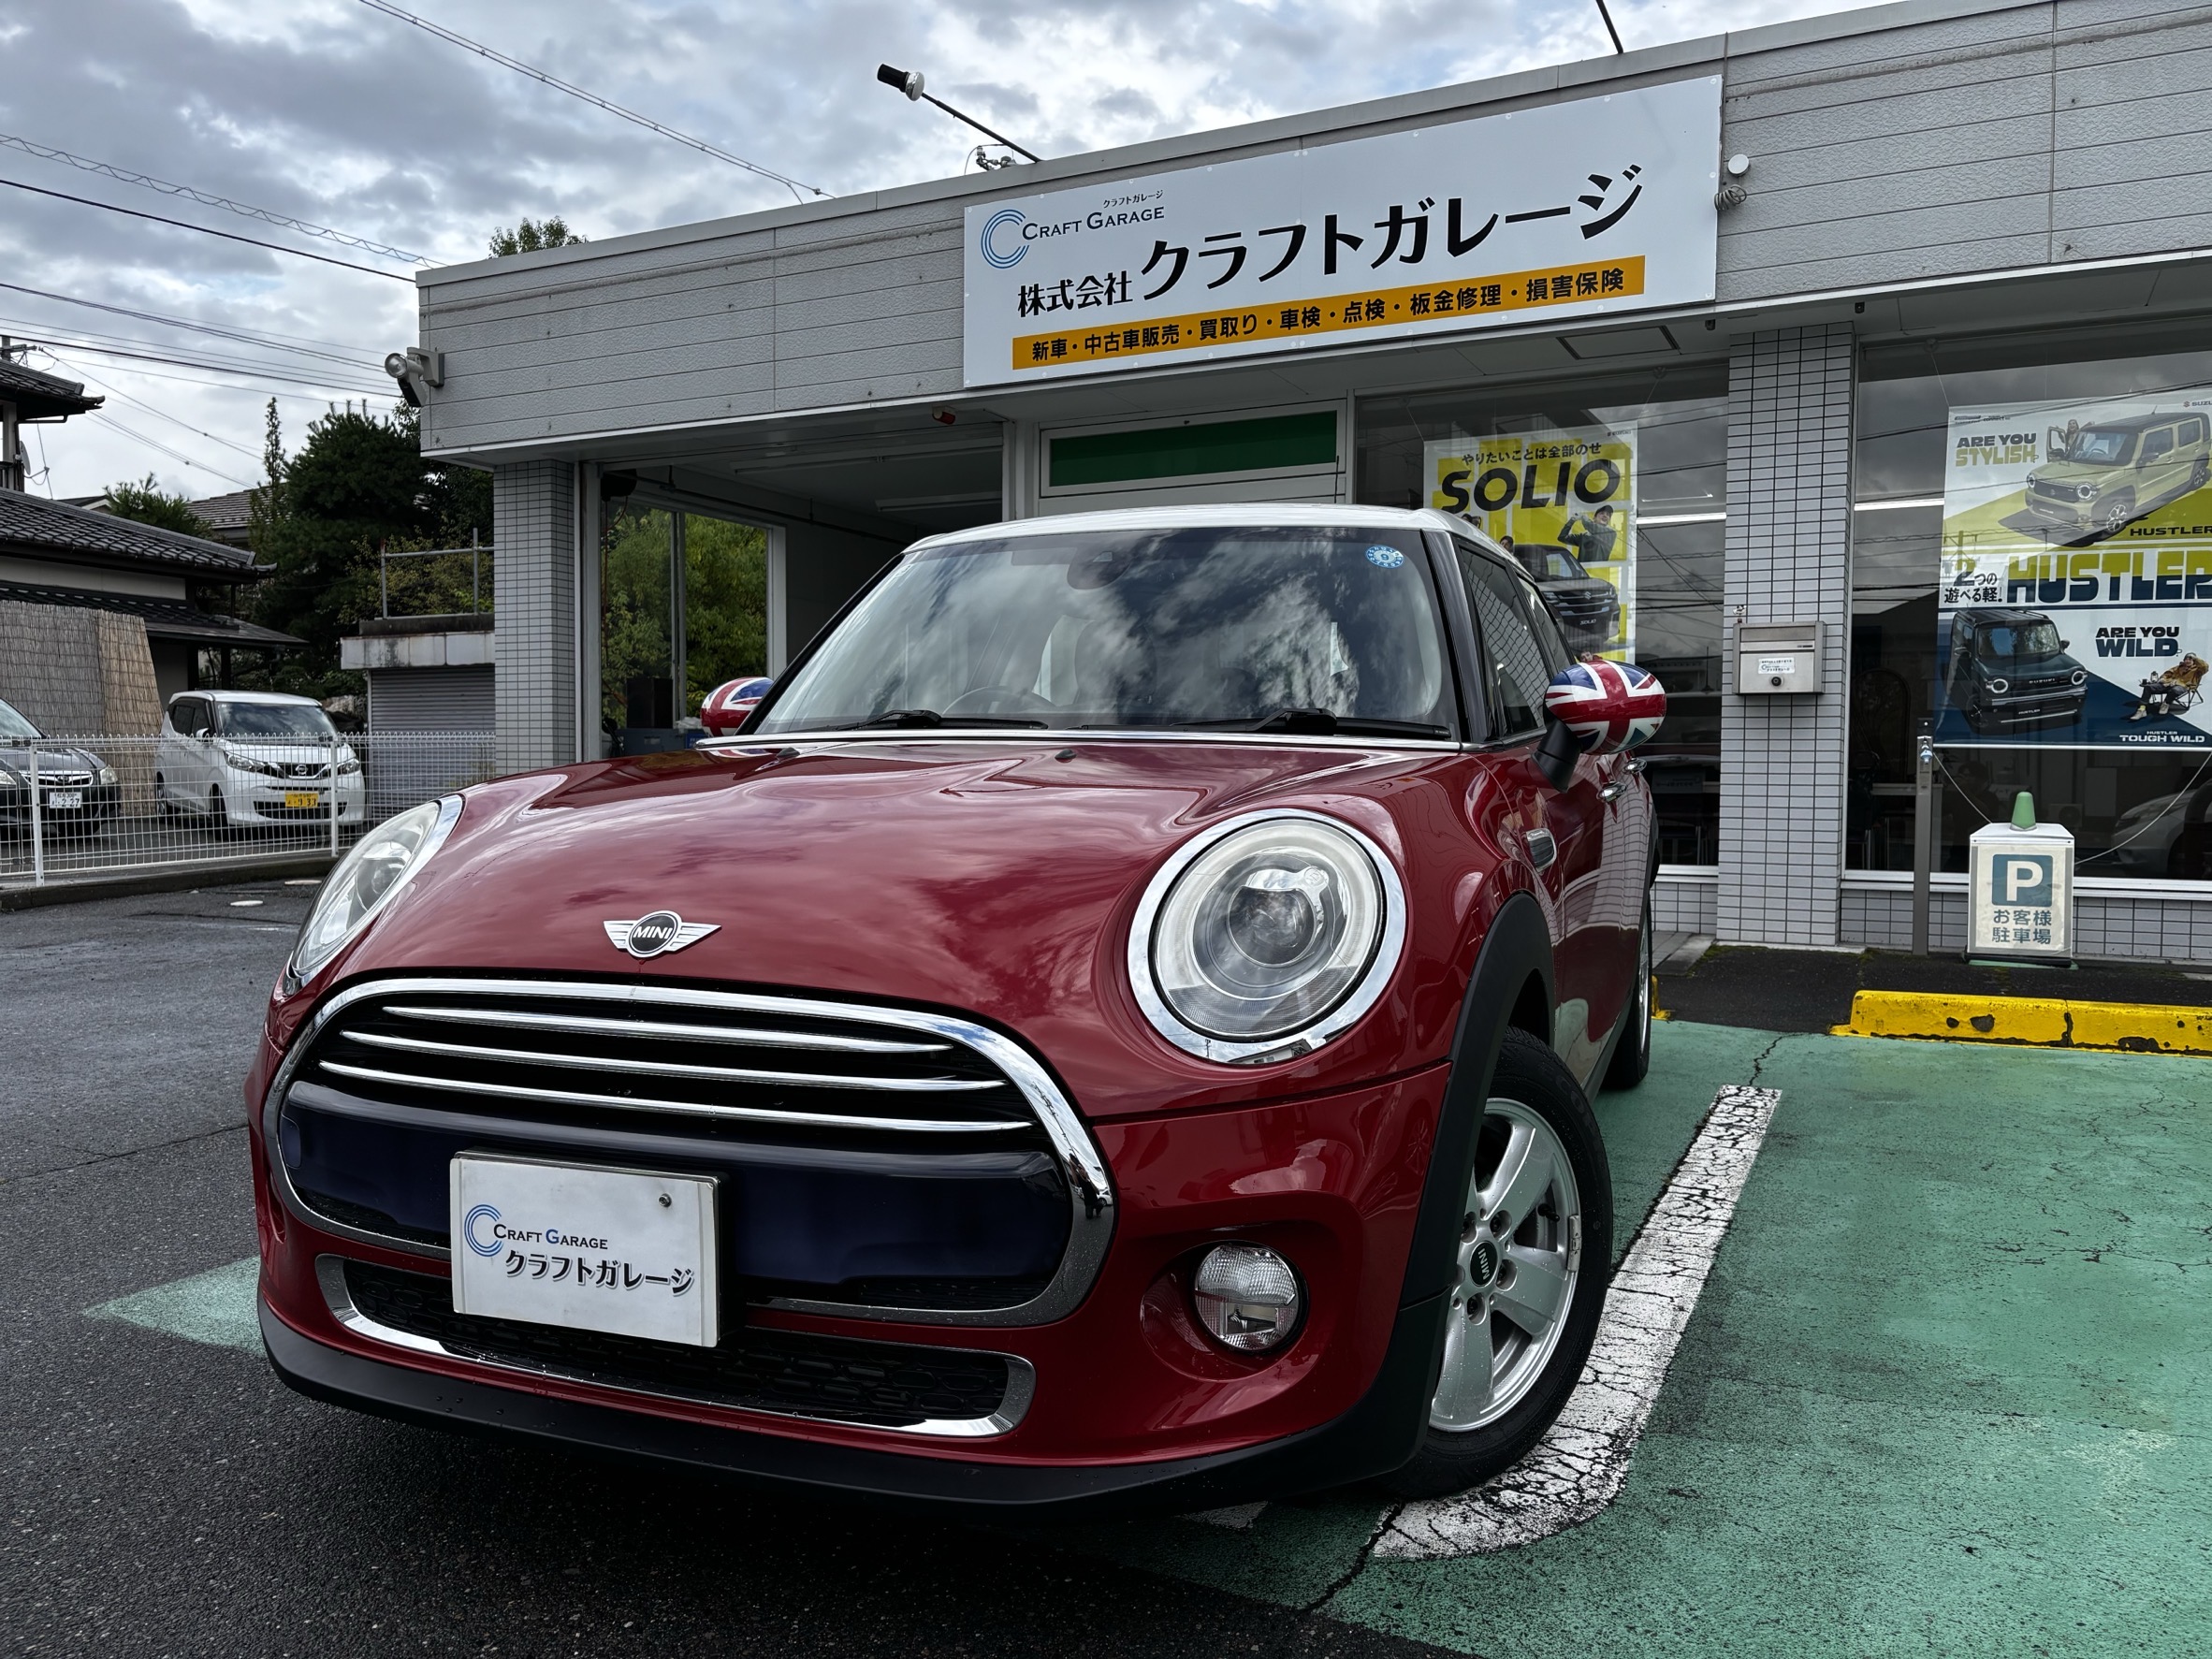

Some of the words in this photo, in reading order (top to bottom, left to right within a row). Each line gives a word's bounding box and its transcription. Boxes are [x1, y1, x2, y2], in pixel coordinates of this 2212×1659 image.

[1102, 190, 1164, 209] クラフトガレージ
[1957, 435, 1996, 448] ARE
[1998, 432, 2037, 445] YOU
[1462, 442, 1602, 466] やりたいことは全部のせ
[1440, 458, 1621, 515] SOLIO
[2130, 525, 2212, 537] HUSTLER
[2006, 549, 2212, 604] HUSTLER
[2095, 627, 2137, 638] ARE
[2139, 626, 2180, 638] YOU
[2170, 735, 2205, 743] WILD
[2006, 860, 2044, 902] P
[1993, 909, 2052, 927] お客様
[633, 925, 673, 939] MINI
[1992, 926, 2051, 945] 駐車場
[505, 1249, 695, 1296] クラフトガレージ
[1477, 1247, 1491, 1280] MINI
